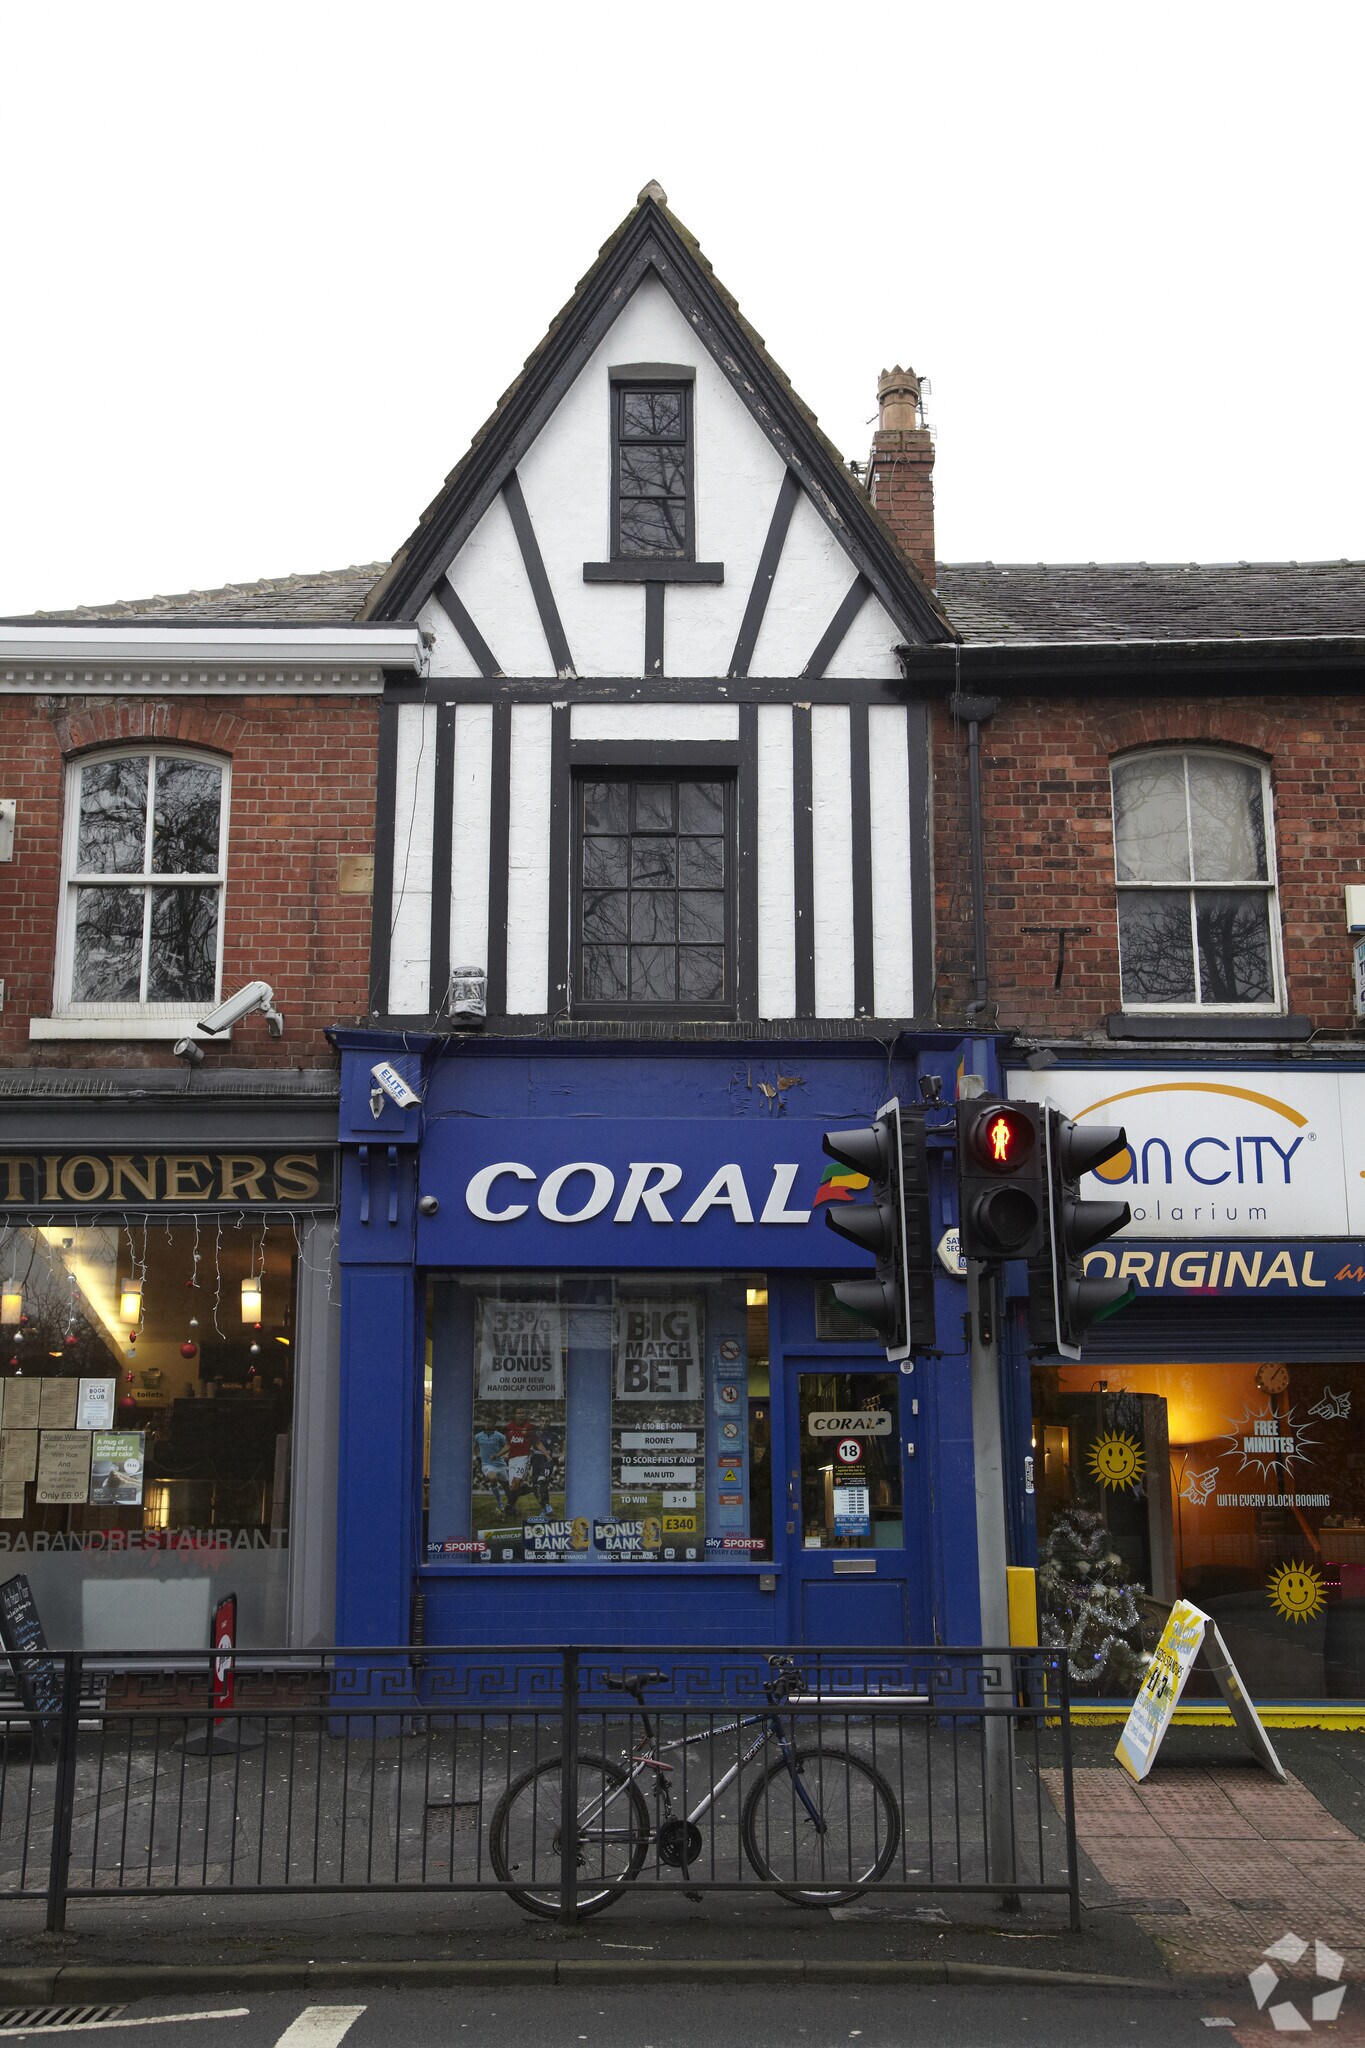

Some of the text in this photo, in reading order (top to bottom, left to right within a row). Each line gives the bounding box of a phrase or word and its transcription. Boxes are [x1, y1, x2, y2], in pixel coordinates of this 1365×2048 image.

[381, 1069, 406, 1098] ELITE
[1184, 1136, 1304, 1185] CITY
[465, 1162, 812, 1223] CORAL
[1133, 1200, 1267, 1221] olarium
[1083, 1251, 1326, 1288] ORIGINAL
[494, 1311, 551, 1332] 33%
[627, 1310, 689, 1341] BIG
[492, 1333, 551, 1356] WIN
[623, 1342, 691, 1358] MATCH
[491, 1356, 552, 1372] BONUS
[499, 1376, 544, 1384] ON OUR NEW
[623, 1358, 694, 1393] BET
[487, 1384, 556, 1392] HANDICAP COUPON
[635, 1422, 682, 1430] A £10 BET ON
[813, 1417, 876, 1430] CORAL
[1254, 1420, 1279, 1436] FREE
[841, 1445, 858, 1457] 18
[1243, 1436, 1295, 1453] MINUTES
[621, 1456, 695, 1464] TO SCORE FIRST AND
[40, 1491, 59, 1502] Only
[61, 1491, 84, 1500] £6.95
[1216, 1494, 1330, 1507] WITH EVERY BLOCK BOOKING
[524, 1521, 573, 1540] BONUS
[595, 1521, 644, 1540] BONUS
[665, 1518, 693, 1530] £340
[427, 1542, 485, 1552] sky SPORTS
[534, 1537, 571, 1550] BANK
[605, 1537, 642, 1550] BANK
[706, 1538, 764, 1548] sky SPORTS
